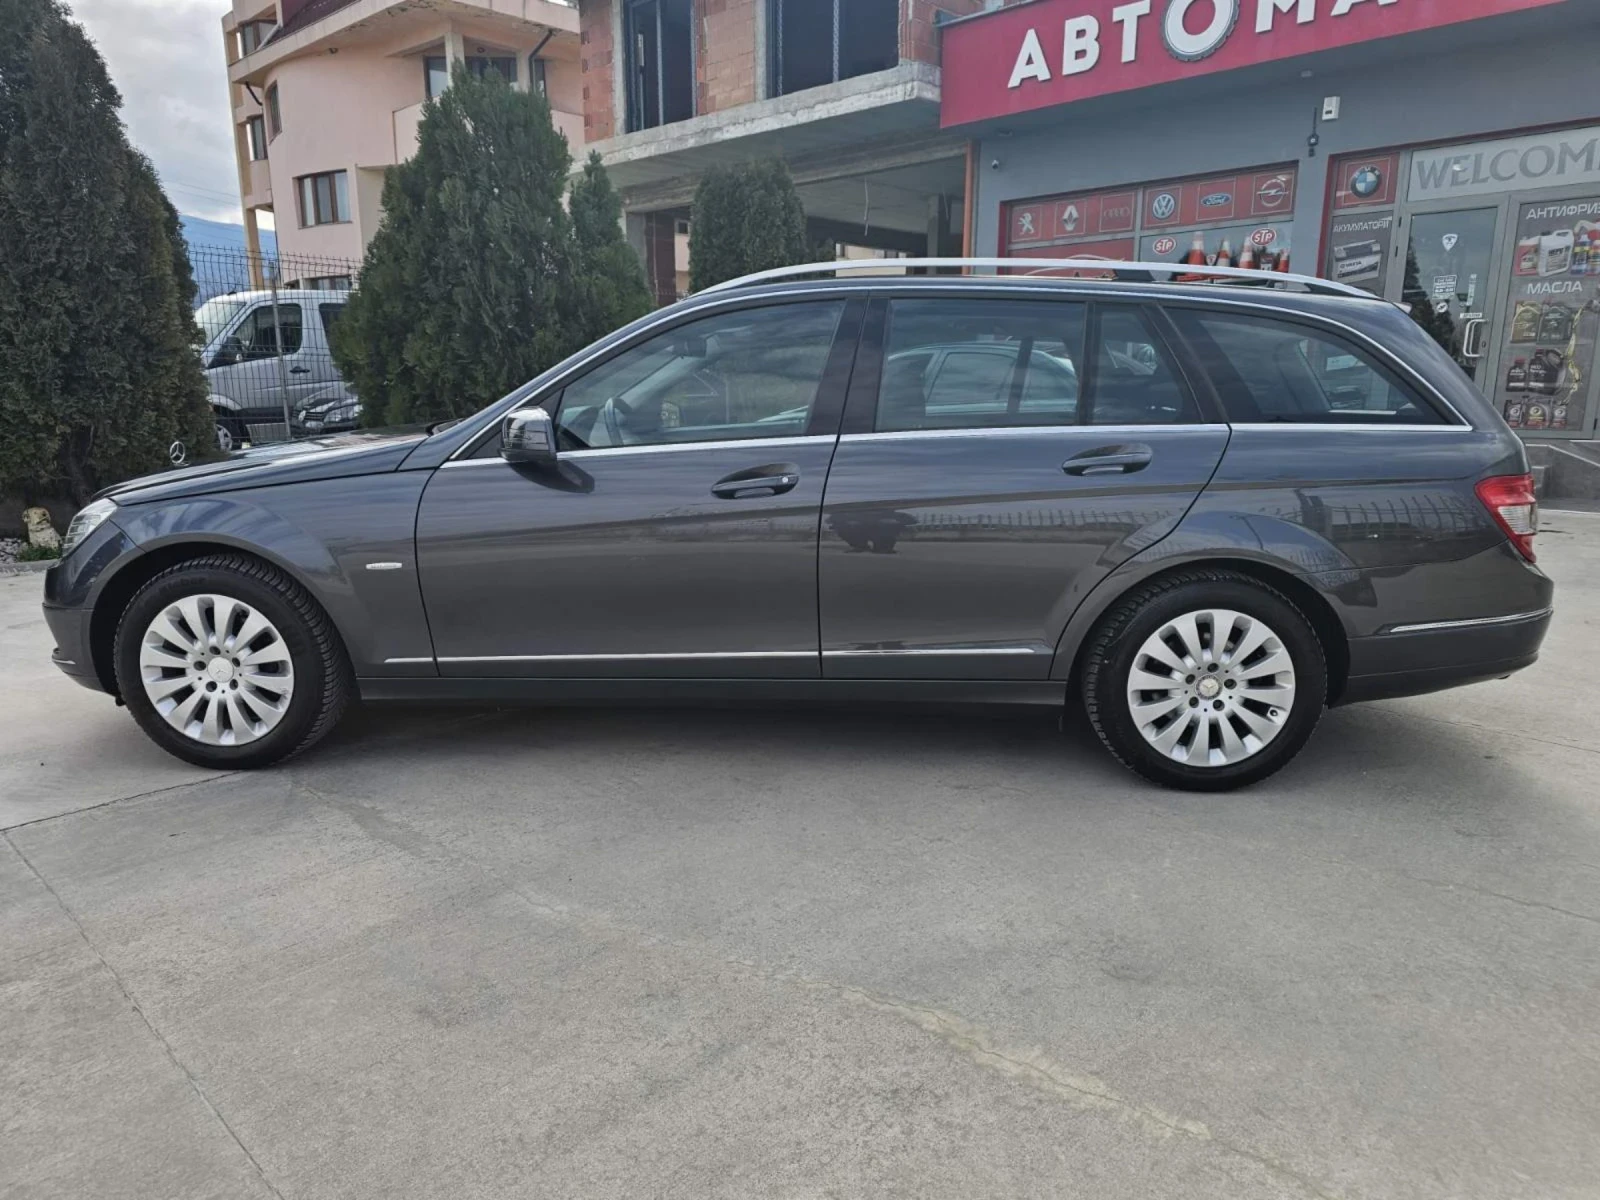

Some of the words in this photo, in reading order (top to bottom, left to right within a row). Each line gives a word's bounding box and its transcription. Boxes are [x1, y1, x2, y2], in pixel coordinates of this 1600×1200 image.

[1416, 138, 1600, 190] WELCOM
[1525, 202, 1600, 219] АНТИФРИ
[1254, 230, 1273, 242] STP
[1155, 239, 1173, 251] STP
[1527, 281, 1583, 295] МАСЛА
